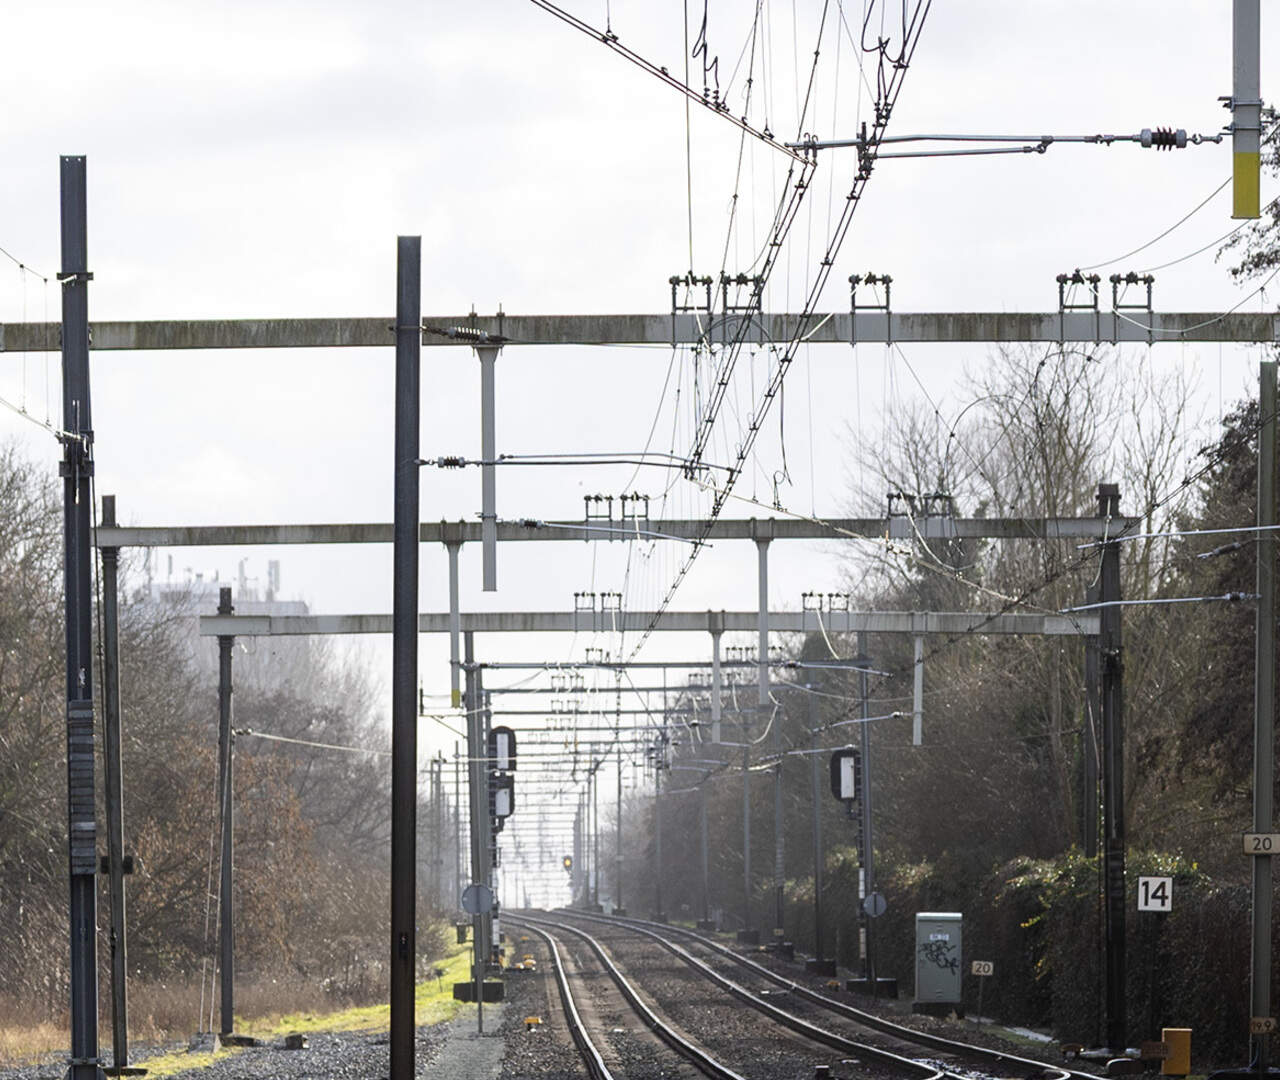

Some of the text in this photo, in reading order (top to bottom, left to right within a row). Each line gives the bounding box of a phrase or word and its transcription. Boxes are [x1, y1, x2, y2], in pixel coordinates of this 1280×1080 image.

[1253, 837, 1272, 851] 20
[1141, 881, 1169, 907] 14
[975, 963, 991, 974] 20
